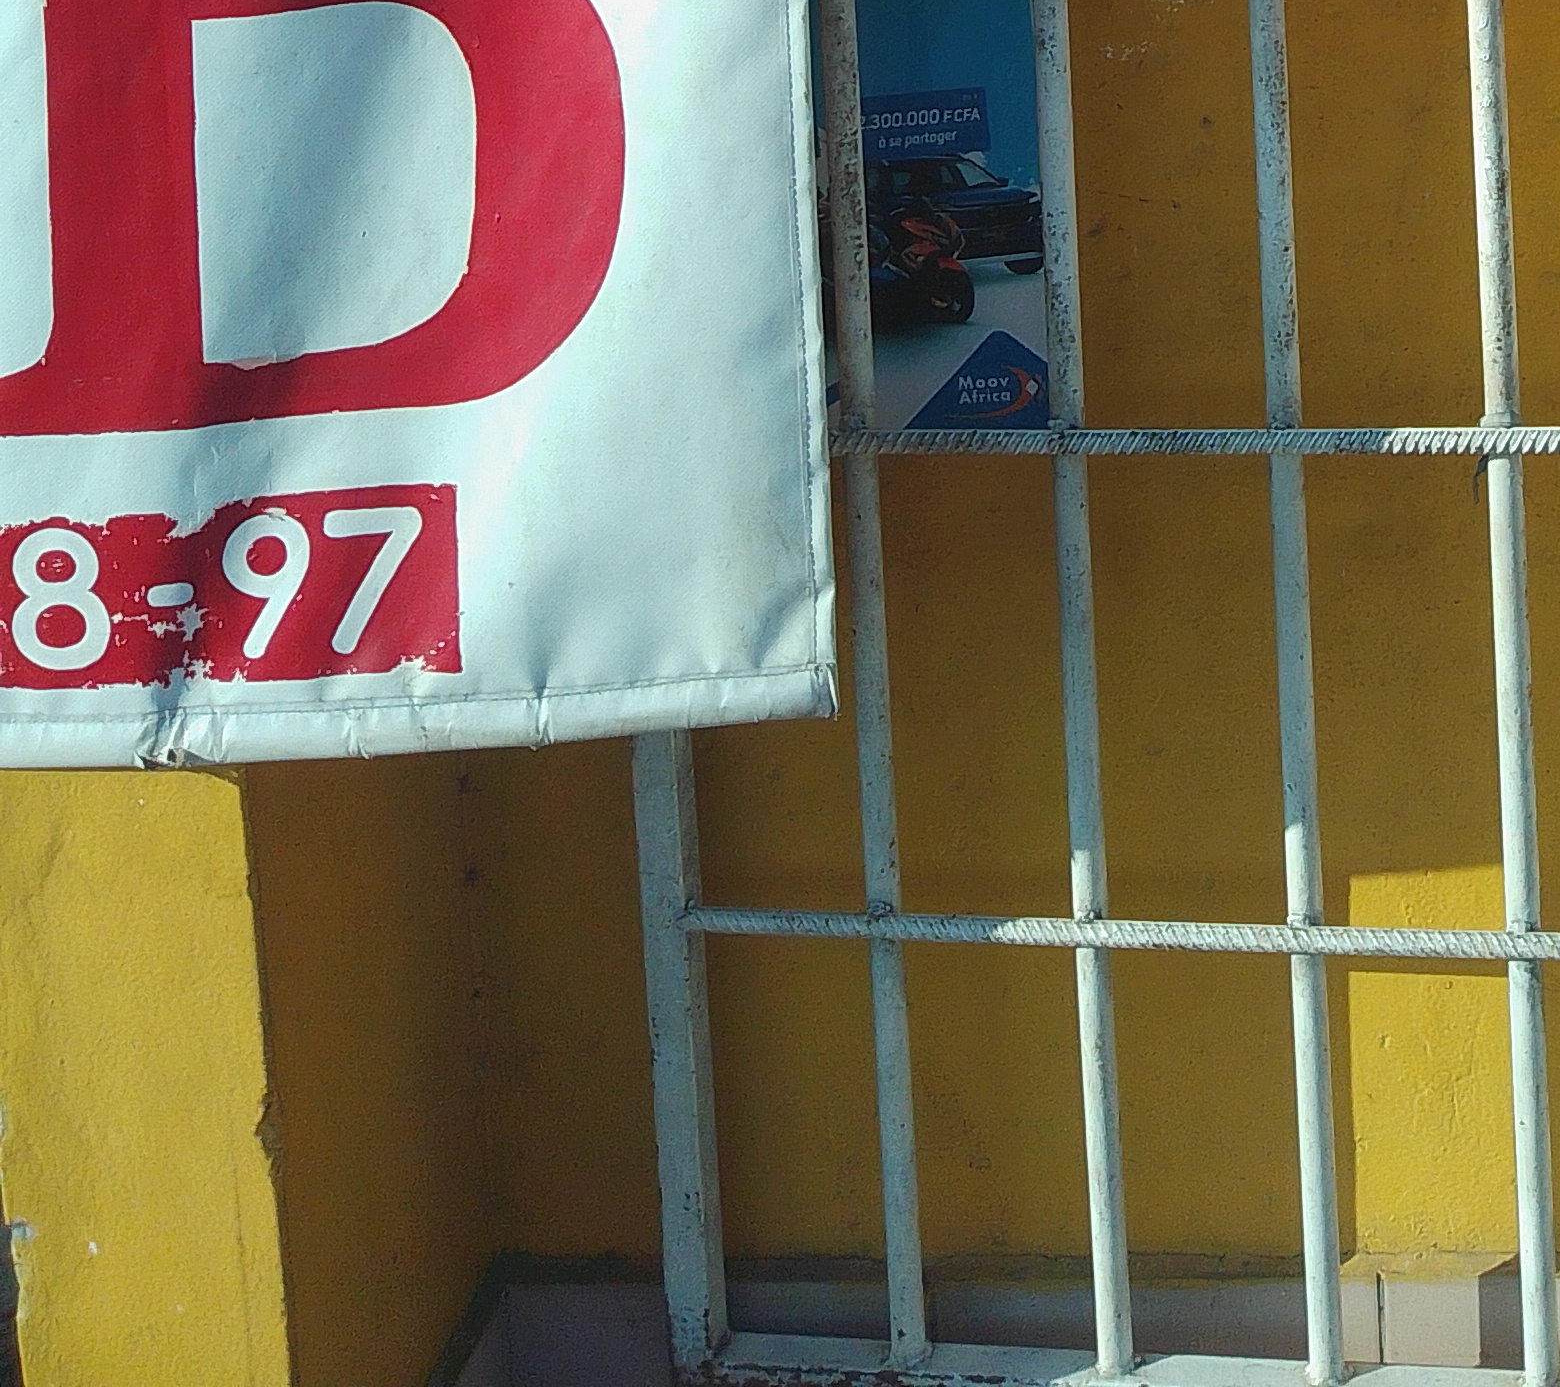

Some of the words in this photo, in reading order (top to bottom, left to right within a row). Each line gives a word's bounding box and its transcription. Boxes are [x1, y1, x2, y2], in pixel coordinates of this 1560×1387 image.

[943, 107, 981, 123] FCFA
[904, 130, 958, 148] partager
[958, 375, 1010, 390] Moov
[959, 389, 1011, 404] Africa
